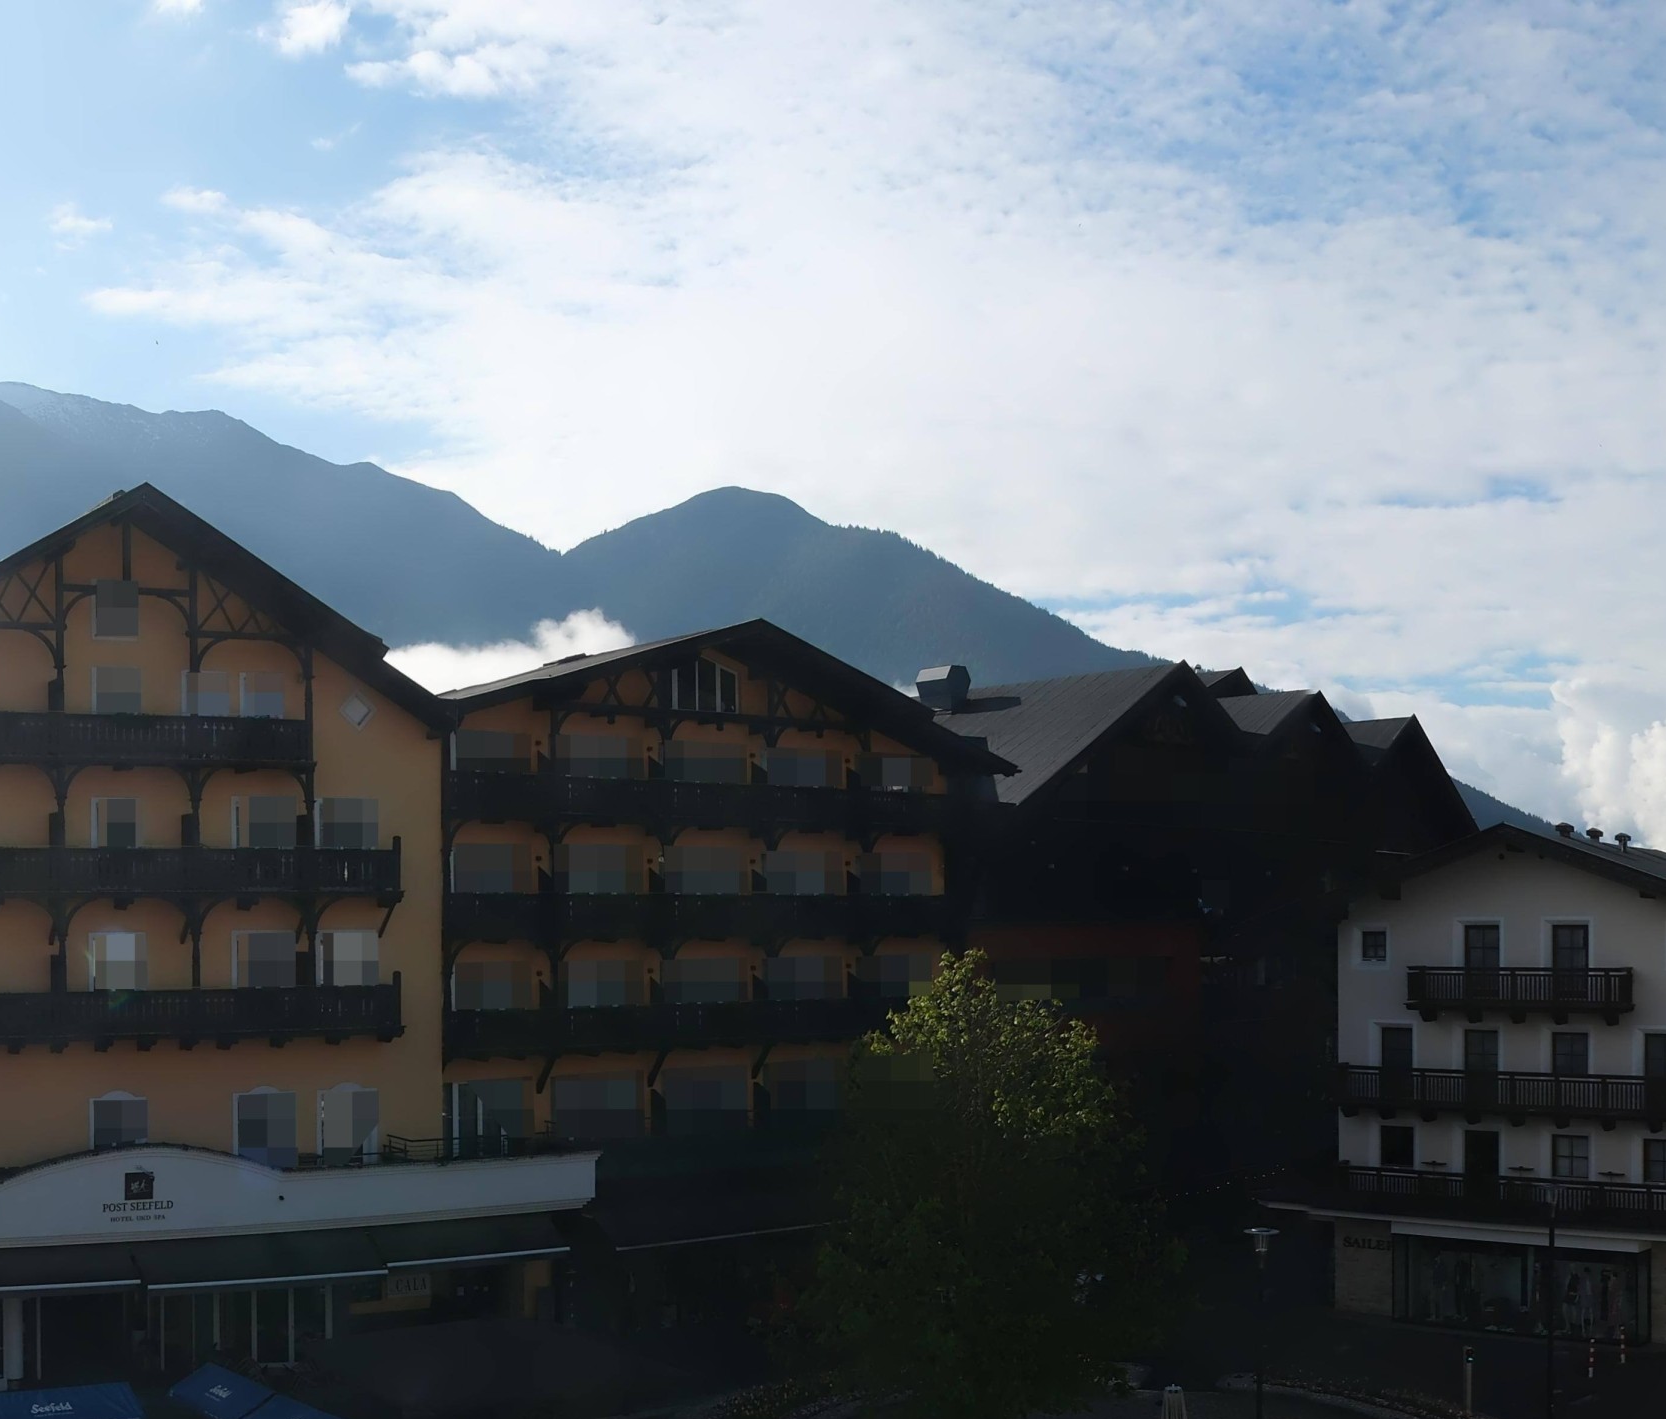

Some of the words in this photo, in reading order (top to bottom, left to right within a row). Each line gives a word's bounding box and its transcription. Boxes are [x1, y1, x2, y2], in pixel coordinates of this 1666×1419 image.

[102, 1203, 128, 1213] POST
[130, 1200, 174, 1211] SEEFELD
[30, 1401, 74, 1414] Seefeld
